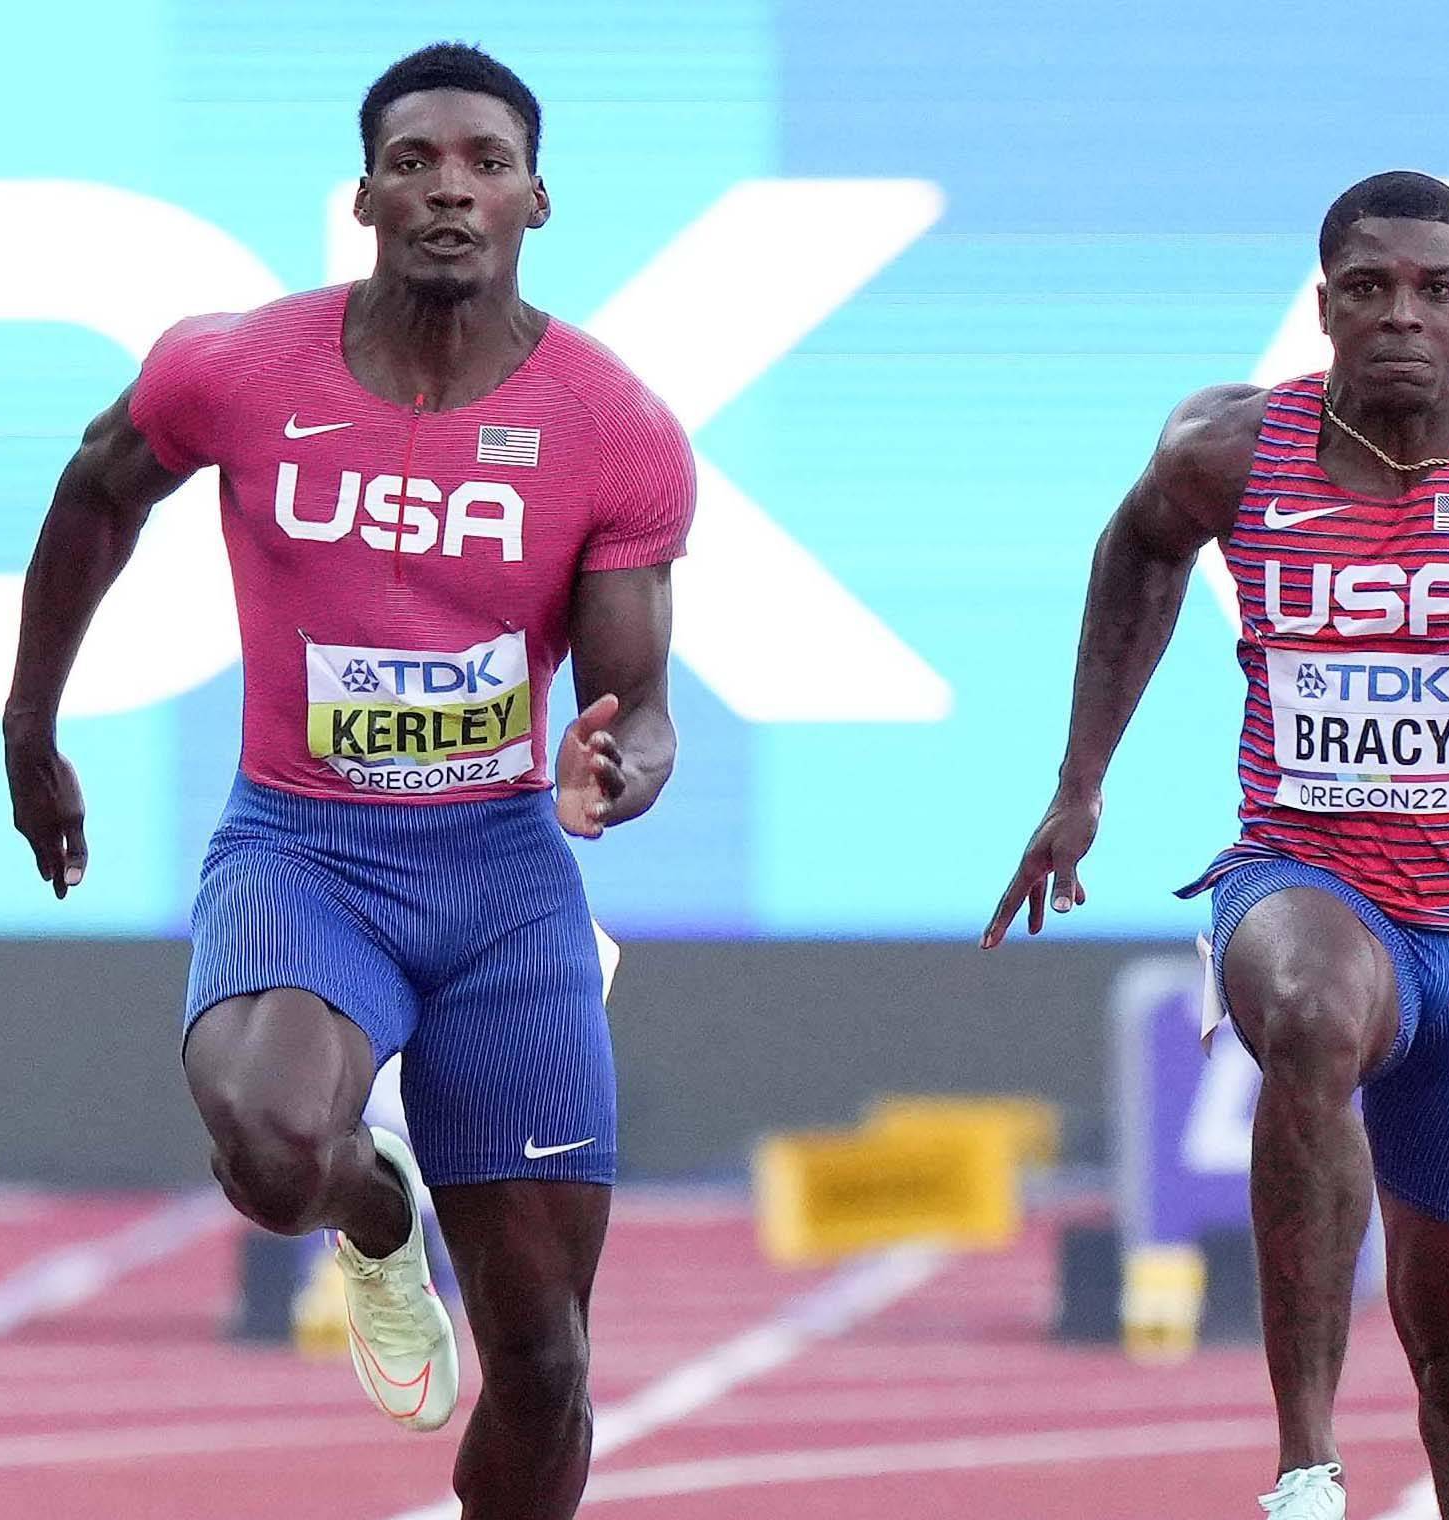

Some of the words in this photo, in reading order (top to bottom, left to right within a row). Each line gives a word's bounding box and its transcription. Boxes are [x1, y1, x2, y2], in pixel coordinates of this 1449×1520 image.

[275, 461, 525, 562] USA
[378, 650, 504, 696] TDK
[332, 694, 517, 757] KERLEY
[346, 758, 500, 791] OREGON22
[1300, 786, 1448, 810] OREGON22
